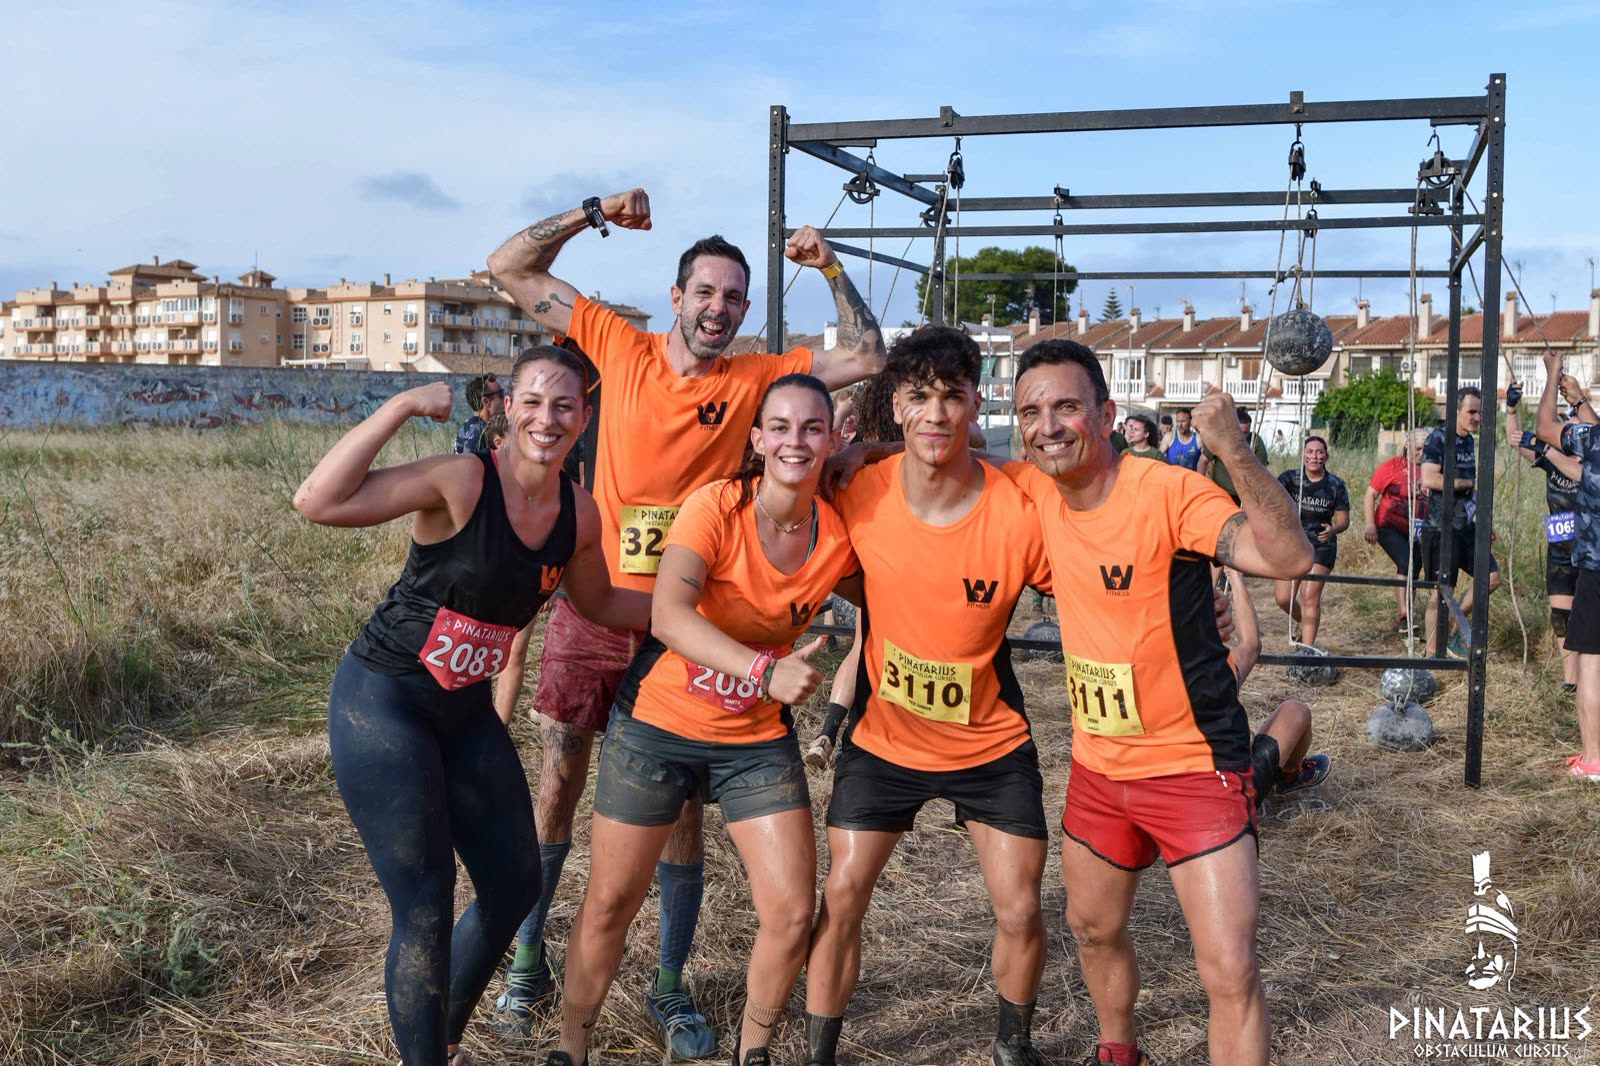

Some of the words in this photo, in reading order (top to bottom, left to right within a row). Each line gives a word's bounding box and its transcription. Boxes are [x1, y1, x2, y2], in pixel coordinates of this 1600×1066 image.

[453, 619, 511, 643] PINATARIUS
[426, 634, 504, 678] 2083
[899, 653, 957, 677] PINATARIUS
[1071, 660, 1116, 680] PINATARIUS
[692, 665, 764, 699] 208
[886, 660, 964, 708] 3110
[1070, 676, 1129, 720] 3111
